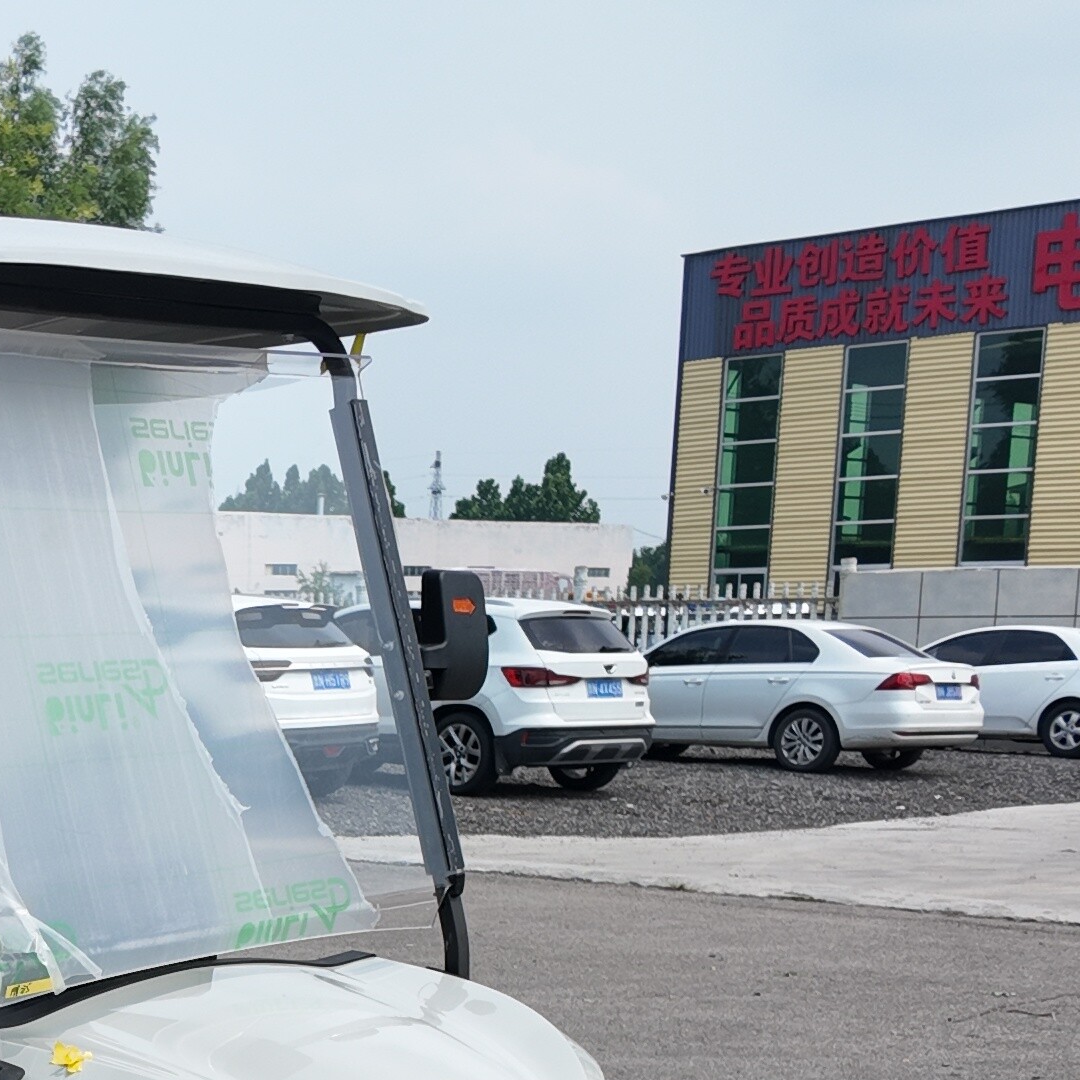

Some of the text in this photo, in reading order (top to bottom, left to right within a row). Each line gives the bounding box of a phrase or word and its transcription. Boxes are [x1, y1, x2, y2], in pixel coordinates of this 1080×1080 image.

[710, 222, 991, 298] 专业创造价值
[732, 274, 1009, 351] 品质成就未来
